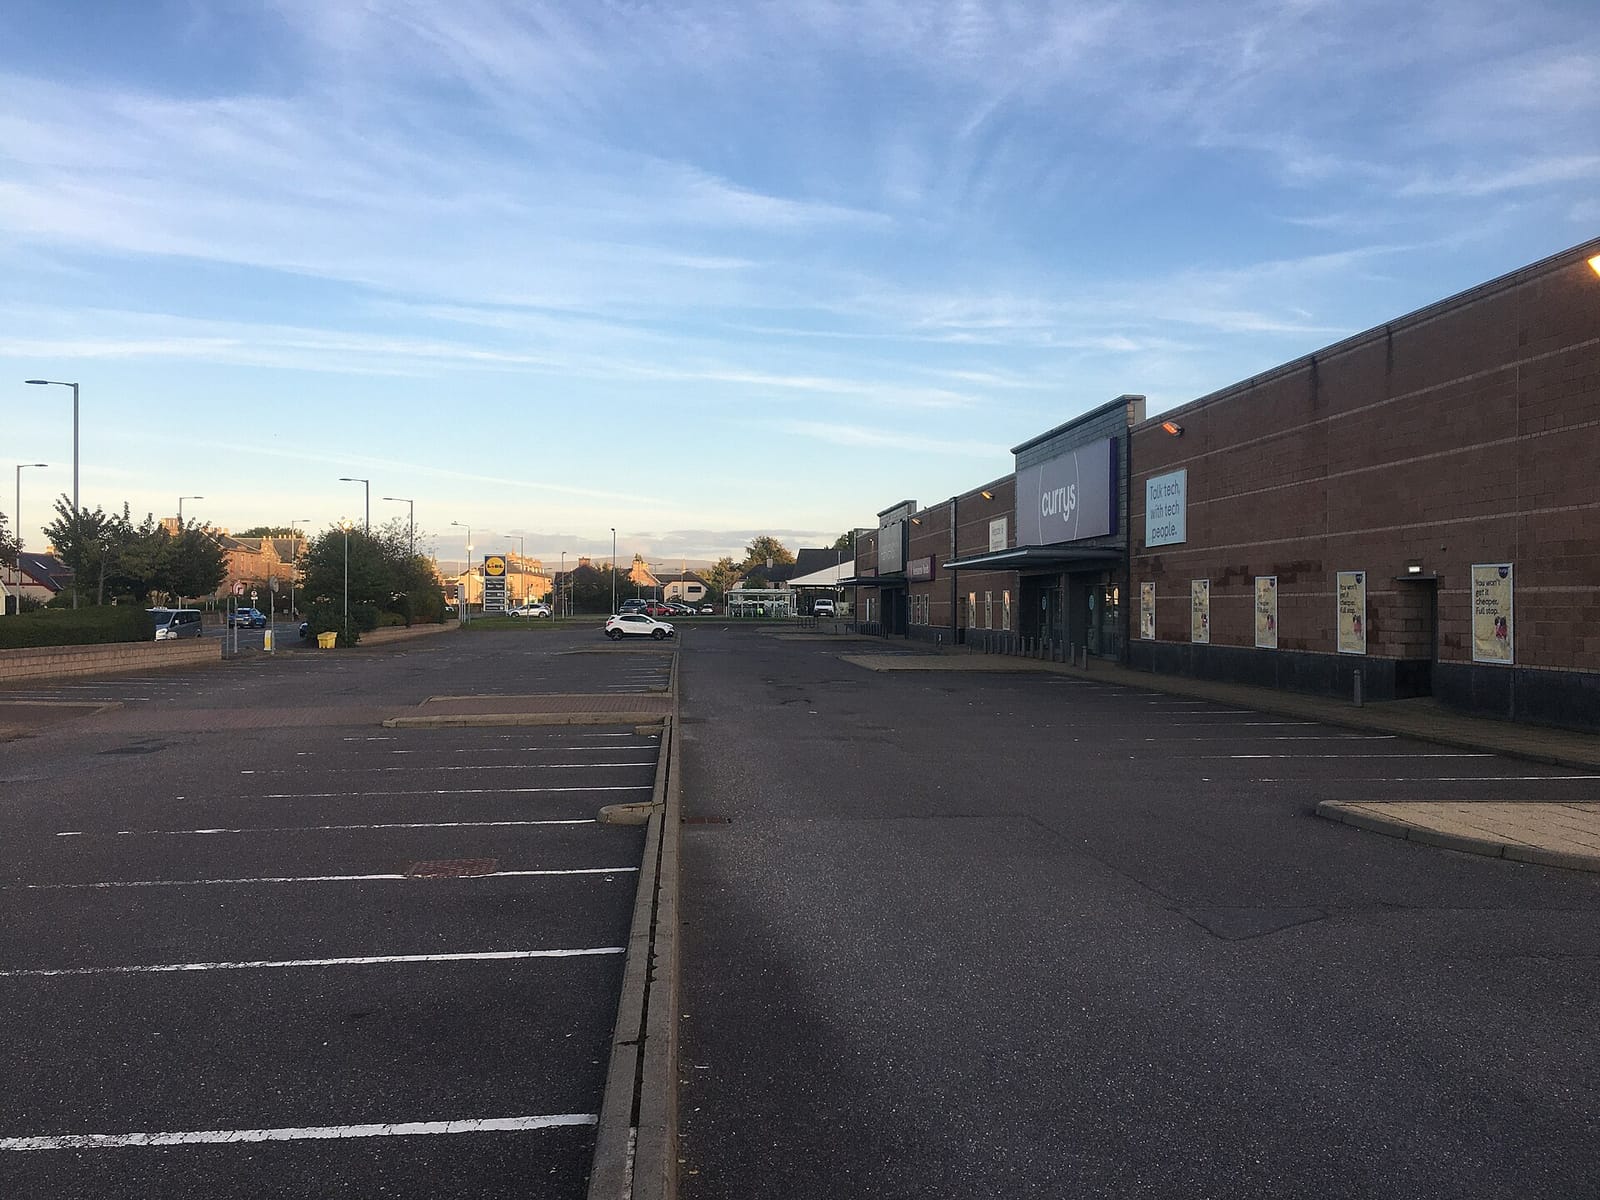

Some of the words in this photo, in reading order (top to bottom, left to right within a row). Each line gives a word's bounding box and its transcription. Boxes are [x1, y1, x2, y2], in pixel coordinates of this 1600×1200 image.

[1150, 484, 1163, 500] Talk
[1042, 484, 1076, 522] currys
[1150, 503, 1164, 519] with
[1164, 500, 1180, 517] tech
[1152, 521, 1177, 543] people.
